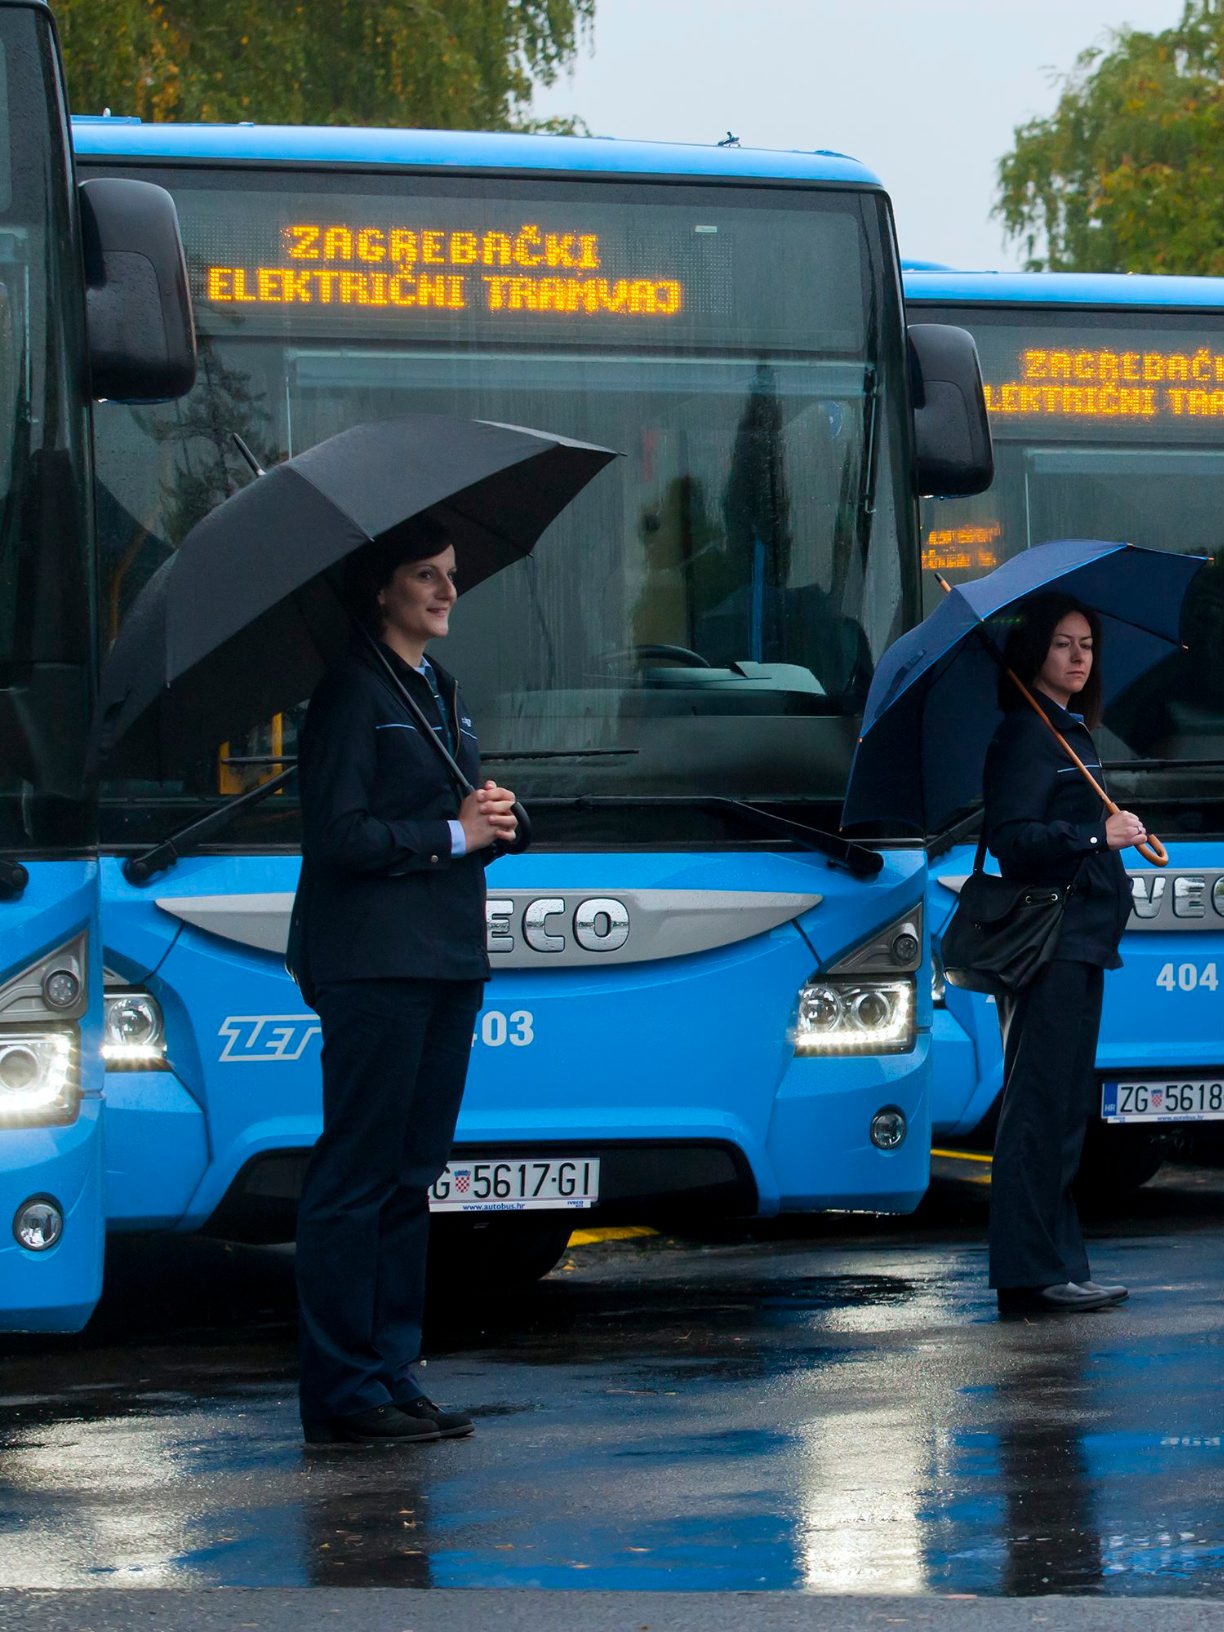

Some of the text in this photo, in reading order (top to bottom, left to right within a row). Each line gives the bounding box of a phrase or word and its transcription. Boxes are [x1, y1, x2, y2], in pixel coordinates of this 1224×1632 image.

[289, 225, 600, 268] ZAGREBAČKI
[207, 264, 684, 315] ELEKTRIČNI TRAMVAJ
[984, 382, 1157, 416] LEKTRIČNI
[486, 897, 630, 954] ECO
[1156, 962, 1219, 992] 404
[218, 1015, 322, 1062] ZET
[472, 1010, 534, 1047] 03
[1120, 1086, 1148, 1113] ZG
[433, 1167, 450, 1200] G
[462, 1202, 525, 1211] www.autobus.hr
